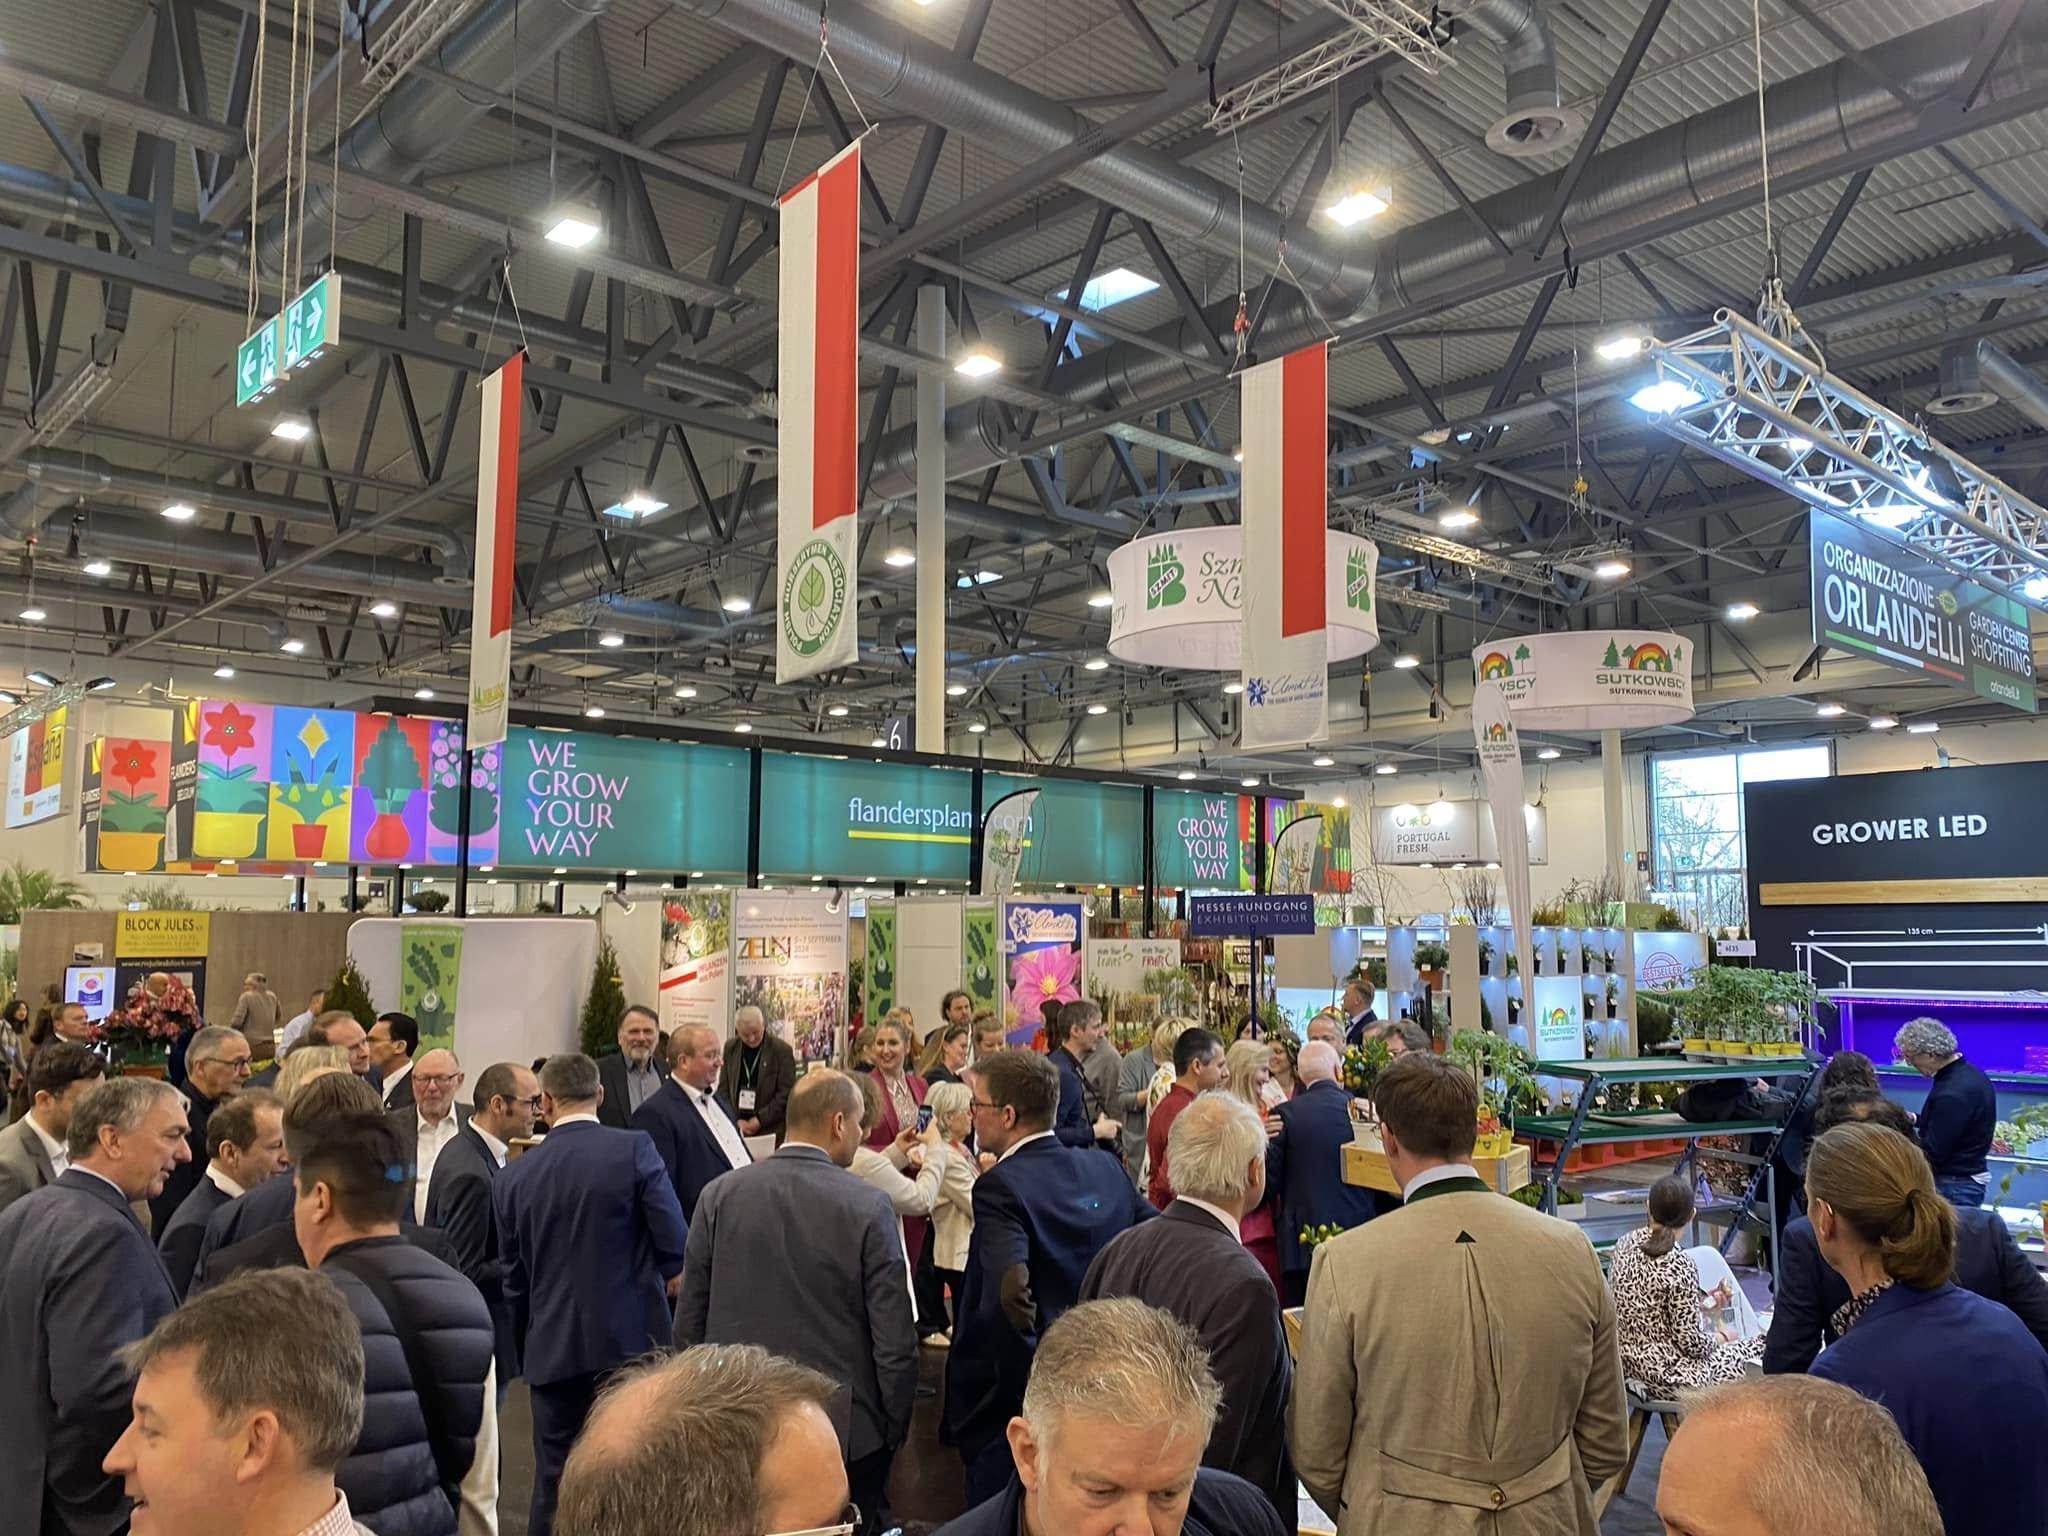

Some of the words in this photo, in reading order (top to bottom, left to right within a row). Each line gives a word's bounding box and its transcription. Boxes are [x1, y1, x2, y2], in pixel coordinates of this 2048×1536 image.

[1150, 568, 1177, 598] SZMIT
[1823, 541, 1935, 609] ORGANIZZAZIONE
[817, 553, 845, 646] ASSOCIATION
[1823, 573, 1965, 666] ORLANDELLI
[1969, 611, 2002, 640] GARDEN
[2003, 625, 2030, 652] CENTER
[1970, 634, 2032, 678] SHOPFITTING
[889, 720, 901, 751] 6
[527, 738, 577, 769] WE
[527, 769, 630, 801] GROW
[526, 798, 615, 829] YOUR
[1203, 799, 1228, 819] WE
[525, 828, 599, 857] WAY
[1178, 817, 1229, 839] GROW
[1396, 831, 1451, 844] PORTUGAL
[1812, 818, 1930, 845] GROWER
[1938, 814, 1988, 838] LED
[1184, 839, 1229, 860] YOUR
[1396, 844, 1429, 854] FRESH
[1193, 860, 1229, 880] WAY
[125, 918, 161, 931] BLOCK
[164, 918, 195, 931] JULES
[1197, 913, 1269, 925] EXHIBITION
[1275, 911, 1308, 923] TOUR
[1907, 928, 1920, 936] 135
[1642, 965, 1683, 979] BESTSELLER
